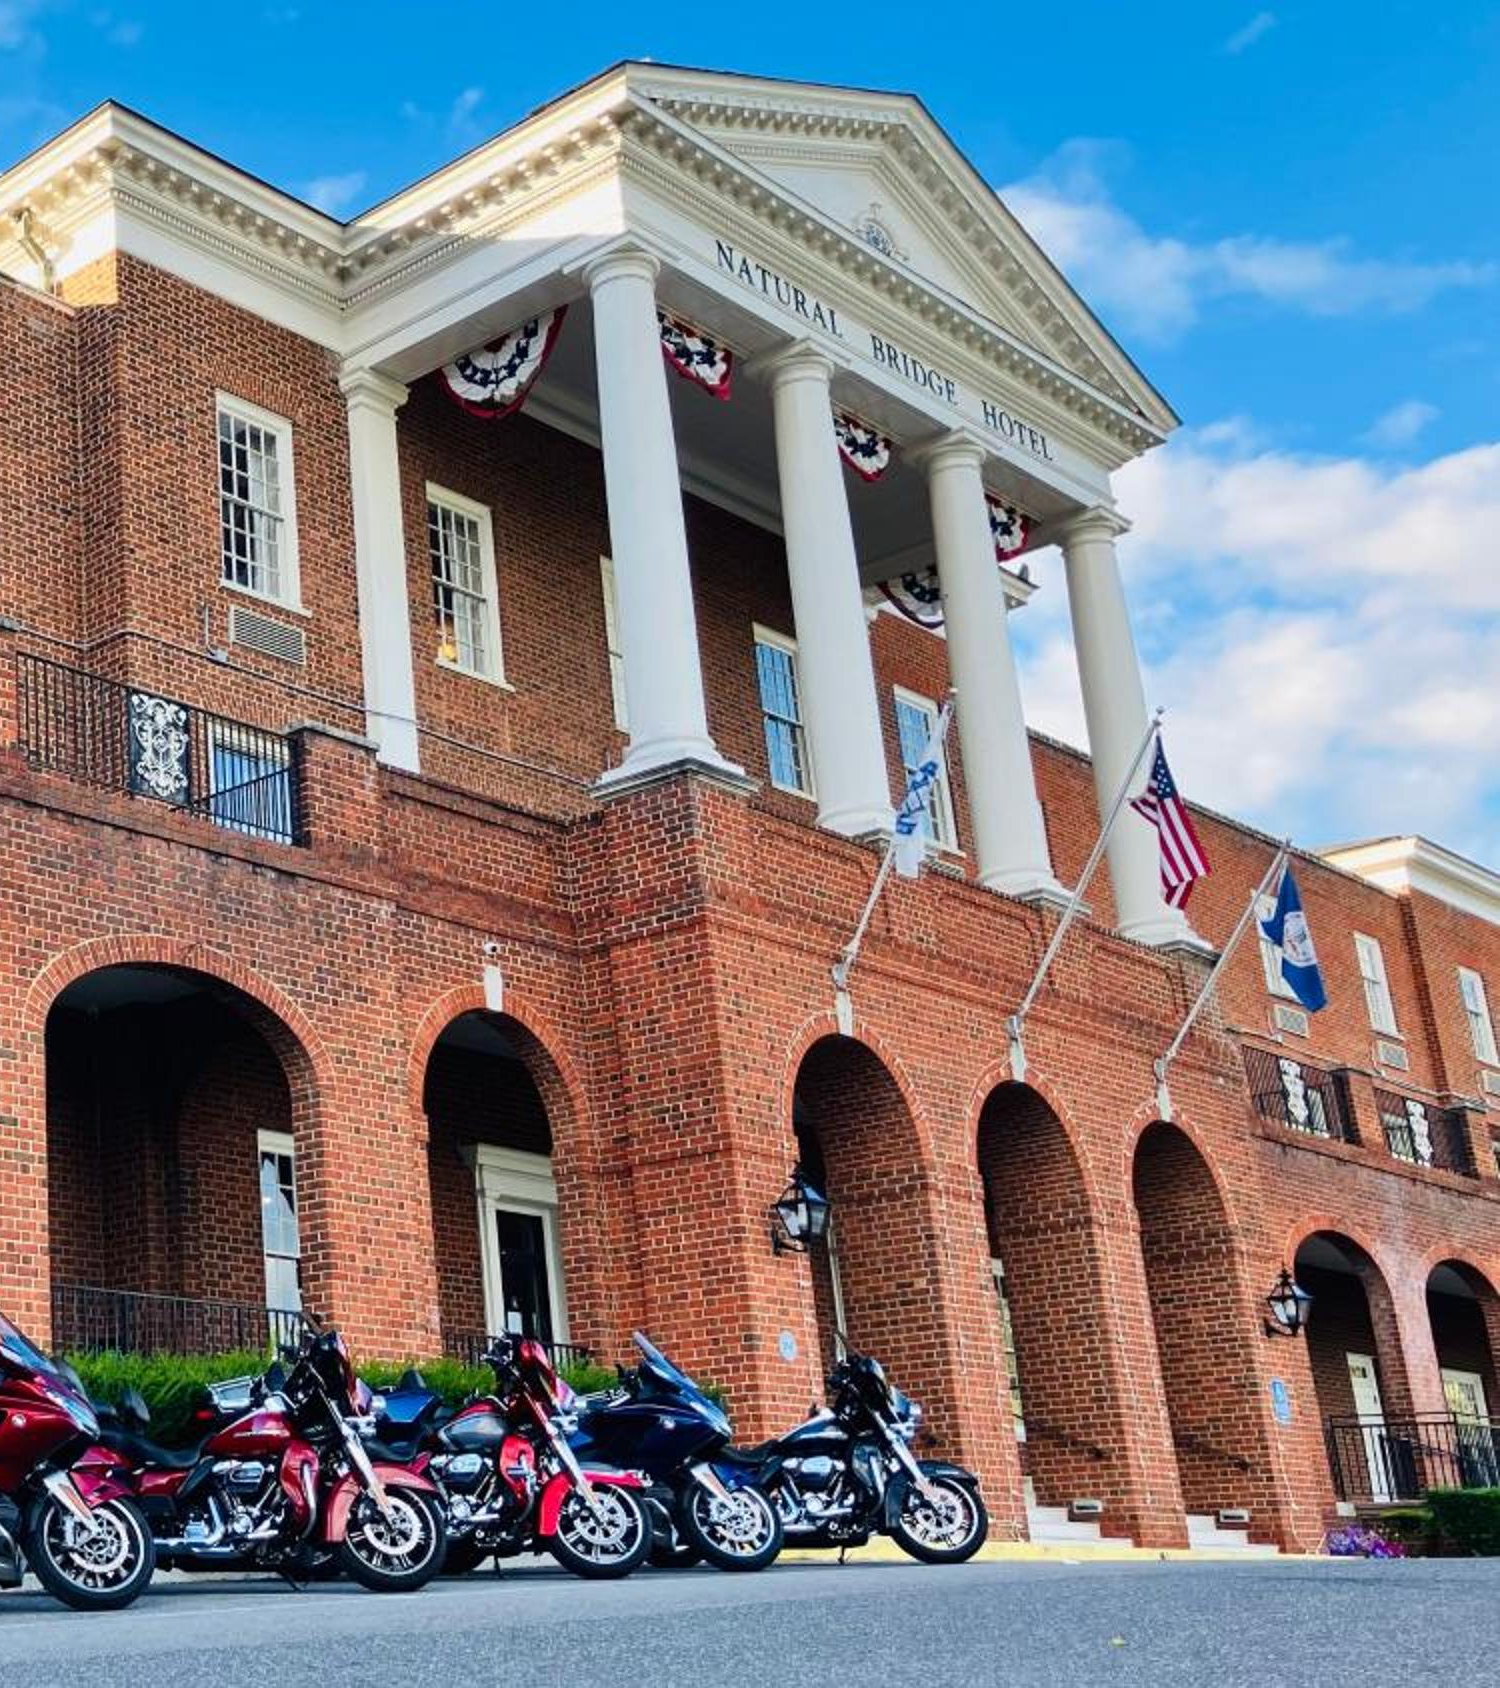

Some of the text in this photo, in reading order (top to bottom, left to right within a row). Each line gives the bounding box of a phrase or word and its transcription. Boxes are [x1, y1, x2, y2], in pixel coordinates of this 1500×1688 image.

[715, 240, 1053, 461] NATURAL BRIDGE HOTEL
